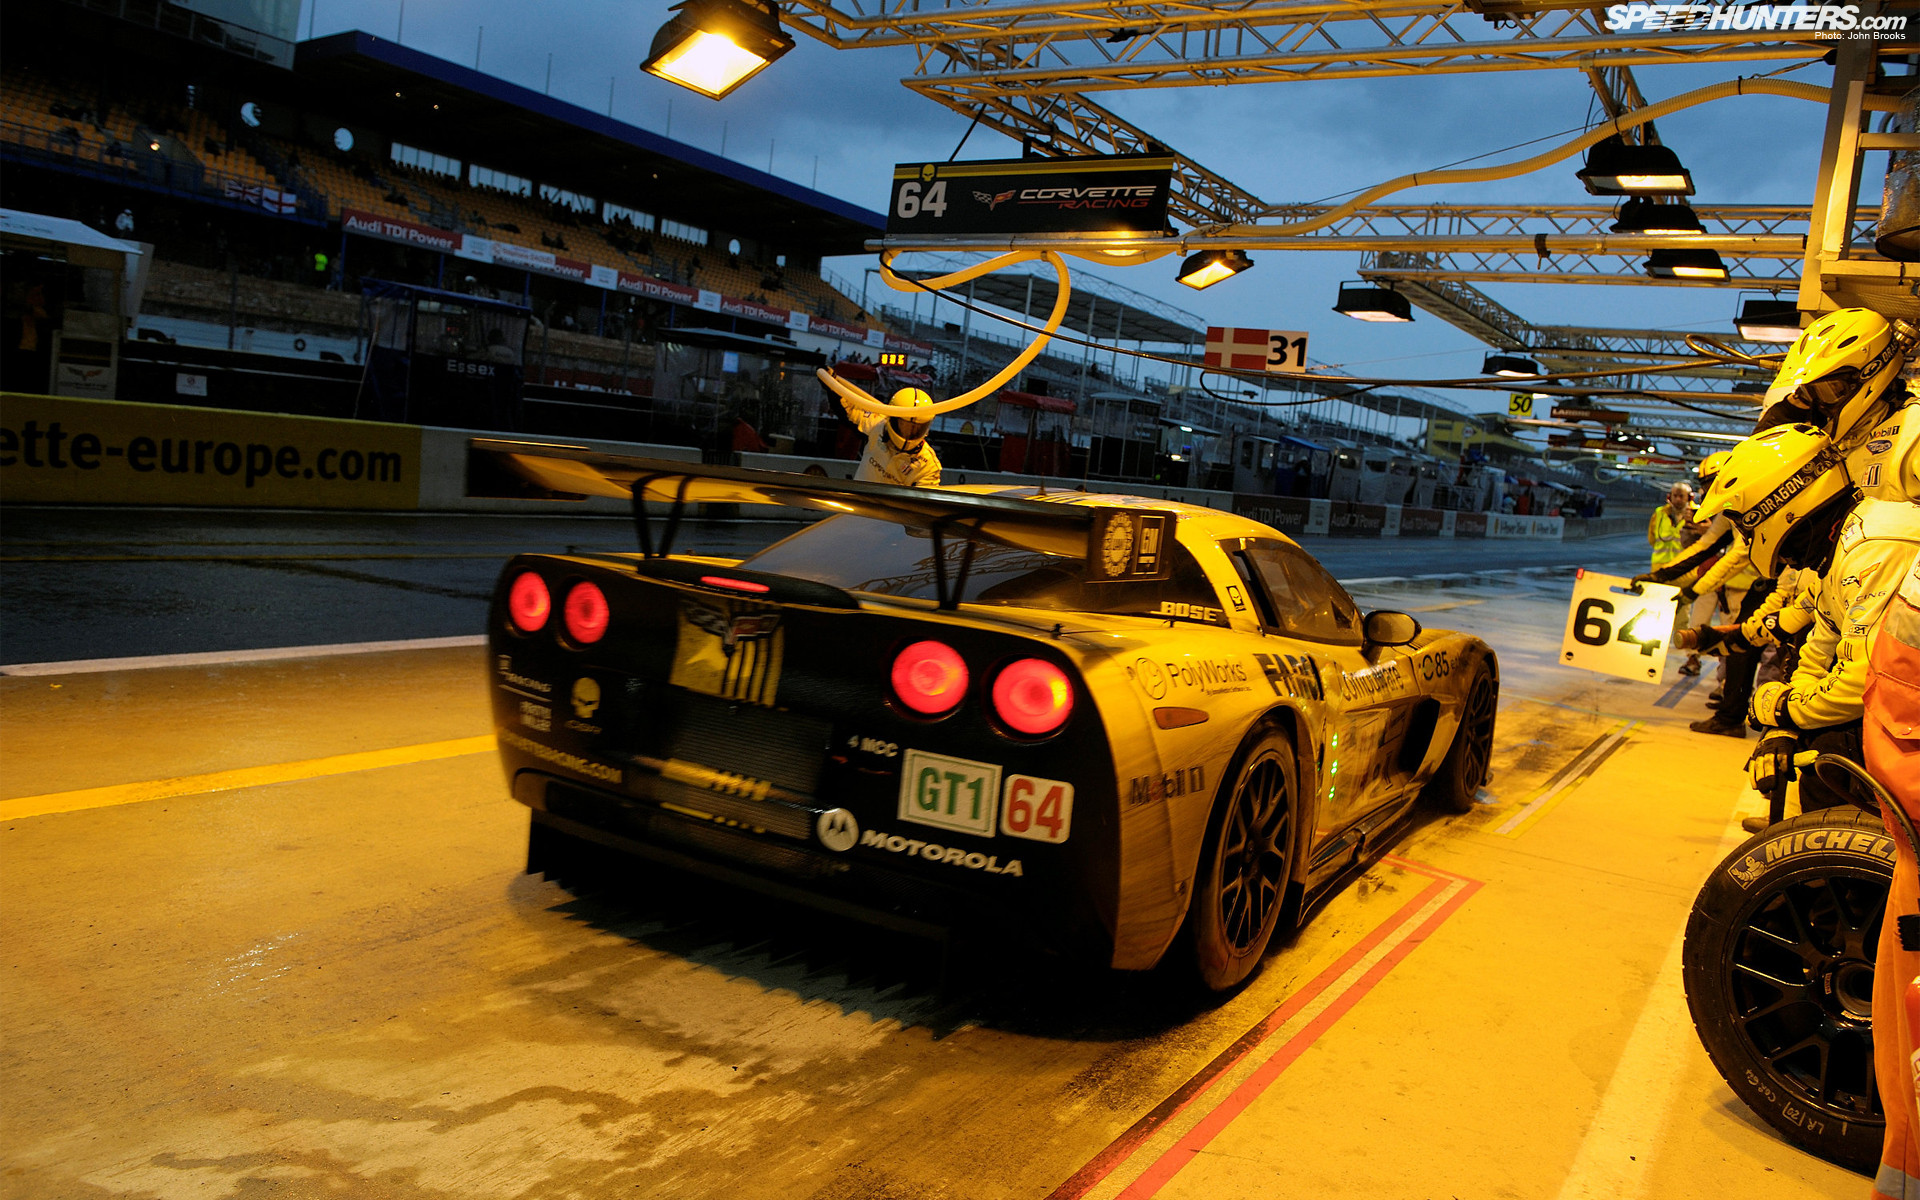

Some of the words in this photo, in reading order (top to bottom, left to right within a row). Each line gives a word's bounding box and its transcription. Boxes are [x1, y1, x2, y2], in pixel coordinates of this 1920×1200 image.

[897, 181, 947, 218] 64
[1019, 185, 1158, 200] CORVETTE
[1057, 198, 1150, 210] RACING
[346, 215, 382, 233] Audi
[384, 222, 407, 239] TDI
[408, 228, 454, 250] Power
[619, 277, 643, 290] Audi
[644, 282, 661, 295] TDI
[661, 287, 693, 302] Power
[722, 301, 743, 314] Audi
[743, 305, 758, 317] TDI
[758, 308, 785, 322] Power
[809, 321, 828, 332] Audi
[840, 327, 864, 340] Power
[1267, 335, 1307, 367] 31
[446, 359, 496, 377] Essex
[1510, 396, 1532, 413] 50
[1869, 427, 1892, 438] Mobil
[0, 420, 401, 488] ette-europe.com
[1760, 474, 1804, 515] DRAGON
[1259, 507, 1274, 525] TDI
[1274, 510, 1303, 526] Power
[1360, 514, 1381, 528] Power
[1150, 601, 1223, 622] BOSE
[1573, 598, 1661, 657] 64
[1166, 659, 1247, 692] PolyWorks
[1130, 768, 1186, 805] Mobil
[917, 766, 986, 820] GT1
[1008, 778, 1066, 839] 64
[859, 829, 1024, 877] MOTOROLA
